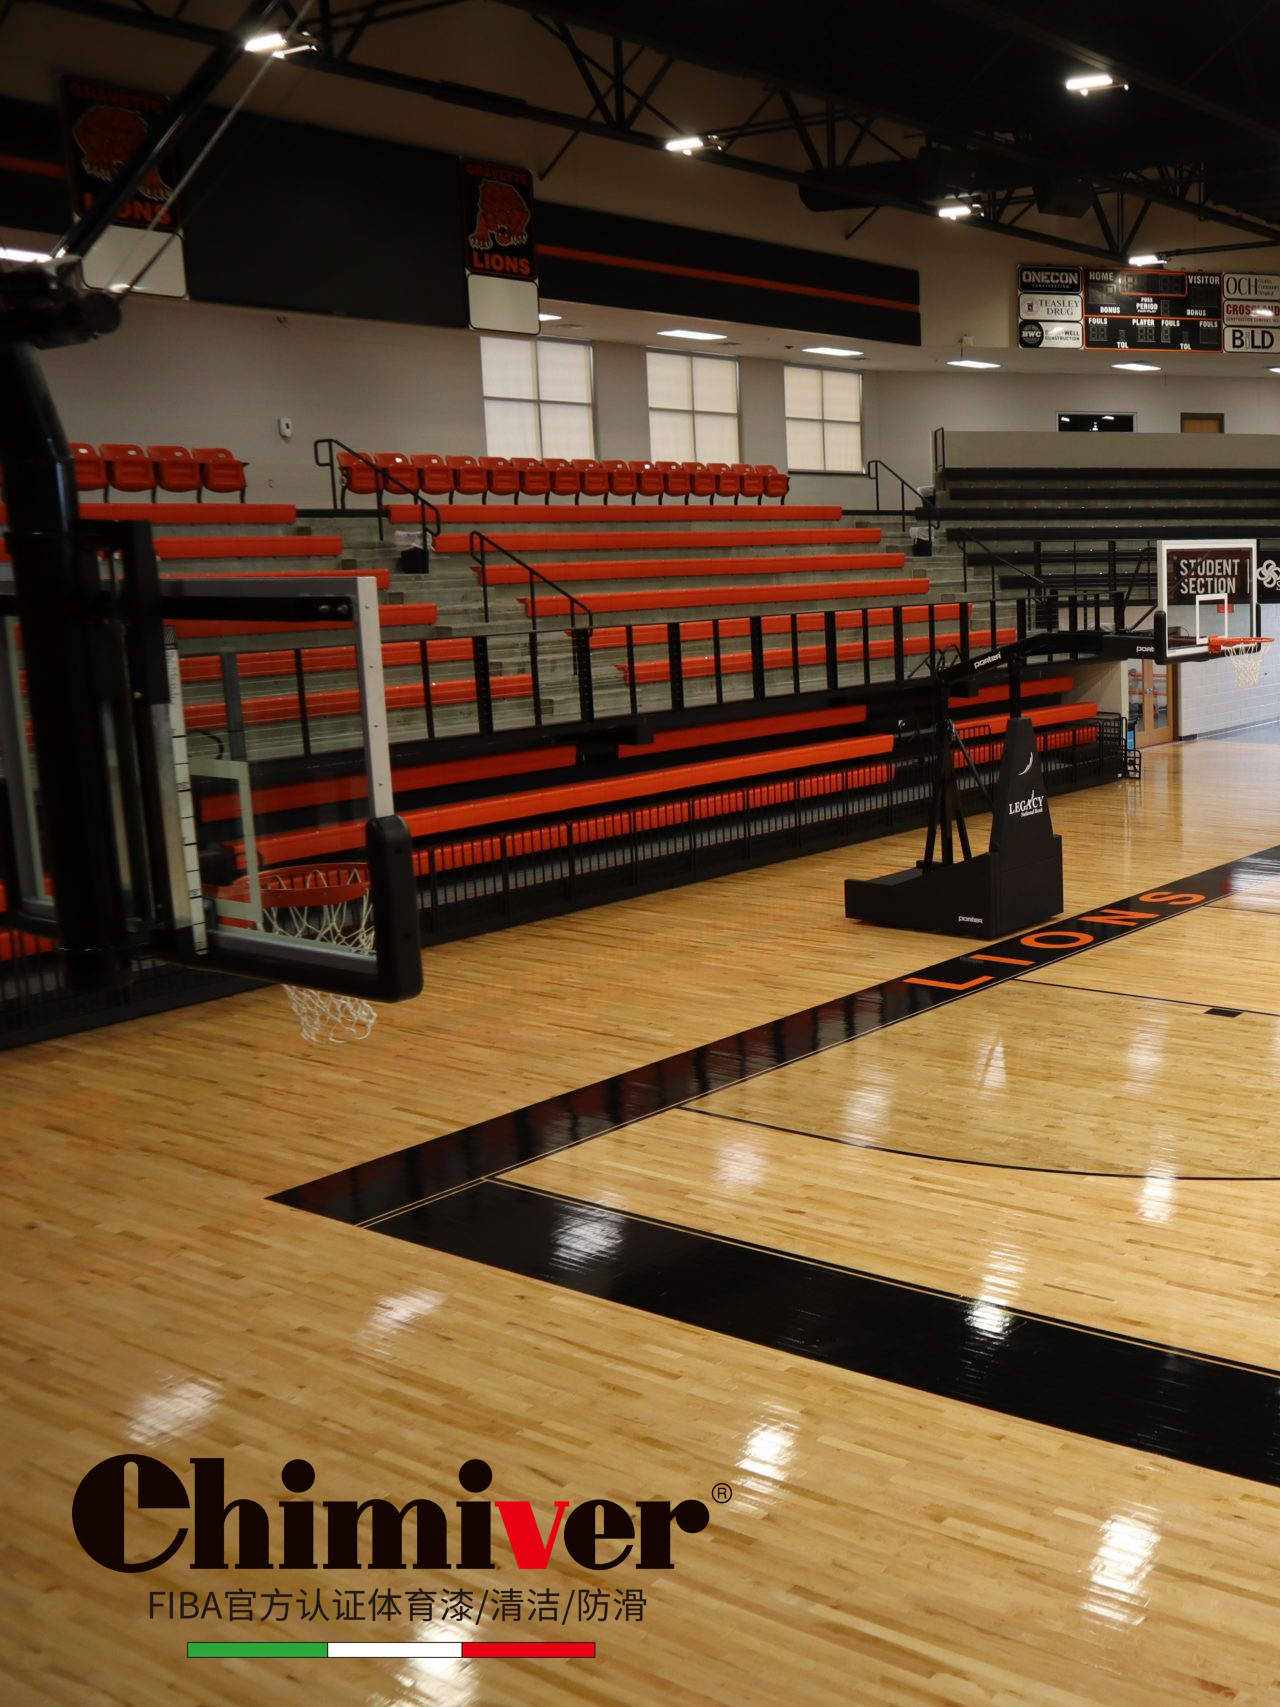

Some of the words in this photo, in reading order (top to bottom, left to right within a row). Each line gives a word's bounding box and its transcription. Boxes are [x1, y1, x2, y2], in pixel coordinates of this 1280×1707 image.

[81, 191, 173, 229] LONS
[471, 250, 532, 276] LIONS
[1022, 271, 1079, 285] ONECON
[1089, 272, 1114, 281] HOME
[1188, 275, 1220, 285] VISITOR
[1226, 277, 1258, 296] OCH
[1040, 299, 1080, 308] TEASLEY
[1100, 306, 1121, 314] BONUS
[1136, 302, 1158, 310] PERIOD
[1226, 304, 1280, 316] CROSSAND
[1047, 307, 1074, 316] DRUG
[1116, 341, 1129, 349] TOL
[1179, 559, 1241, 576] STUDENT
[1180, 577, 1236, 594] SECTION
[974, 652, 1001, 669] porter
[1009, 795, 1045, 815] LEGACY
[901, 890, 1207, 991] LIONS
